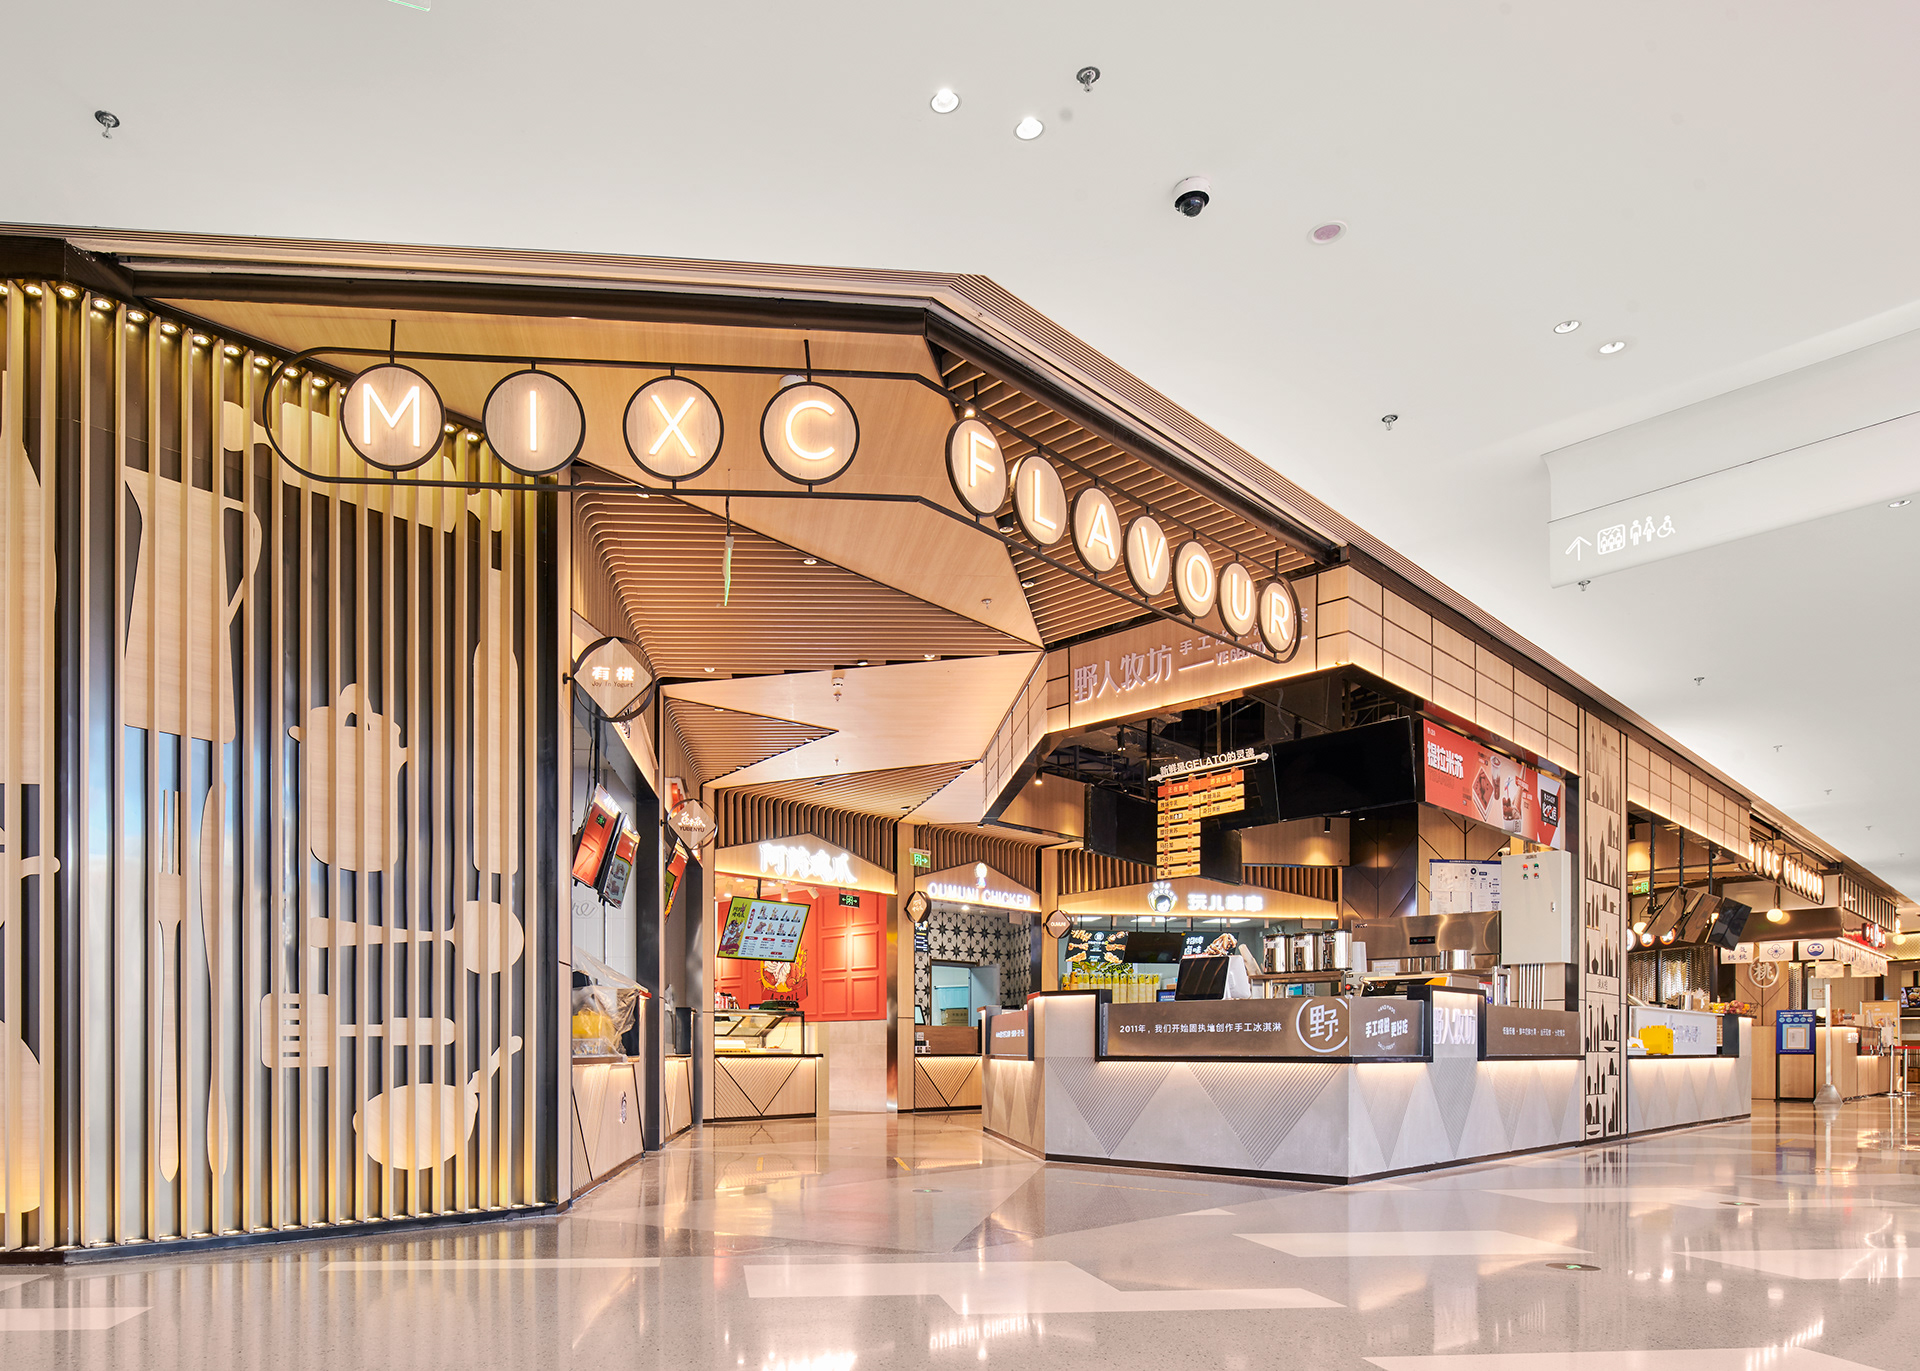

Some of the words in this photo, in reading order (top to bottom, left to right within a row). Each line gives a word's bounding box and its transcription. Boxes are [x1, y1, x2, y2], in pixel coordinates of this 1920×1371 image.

[362, 382, 836, 460] MIXC
[969, 430, 1290, 642] FLAVOUR
[613, 681, 634, 689] Yogurt
[1074, 644, 1173, 704] 野人牧坊
[982, 889, 1032, 908] CHICKEN
[1309, 1004, 1339, 1042] 野
